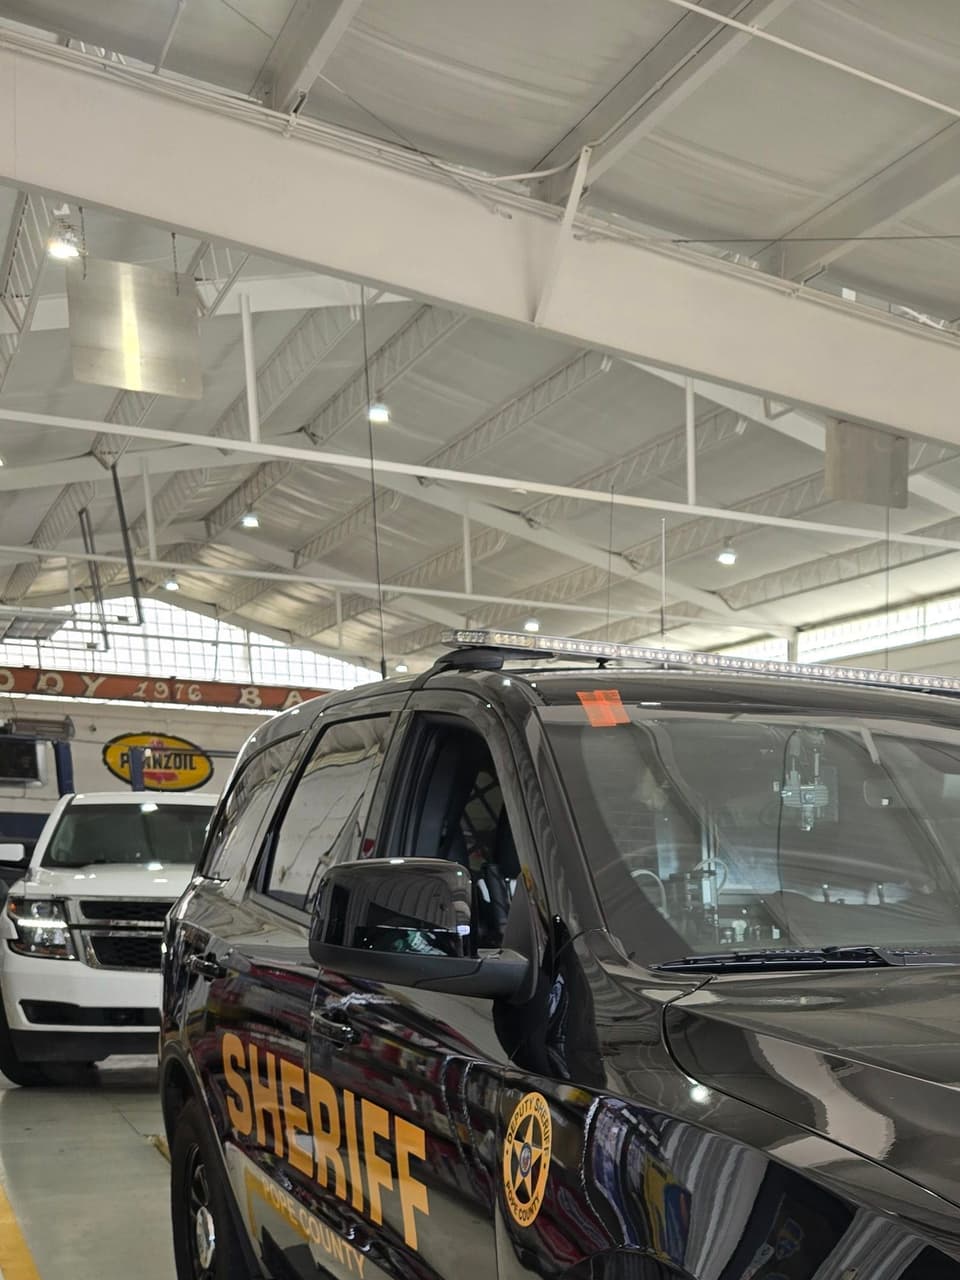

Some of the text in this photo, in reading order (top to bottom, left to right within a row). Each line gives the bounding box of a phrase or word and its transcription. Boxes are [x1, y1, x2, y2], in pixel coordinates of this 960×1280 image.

[132, 680, 202, 702] 1976
[120, 752, 197, 770] PNNZOIL
[222, 1032, 429, 1251] SHERIFF
[507, 1097, 550, 1155] DEPUTY SHERIFF
[506, 1181, 541, 1221] POPE COUNTY
[262, 1179, 365, 1280] POPE COUNTY
